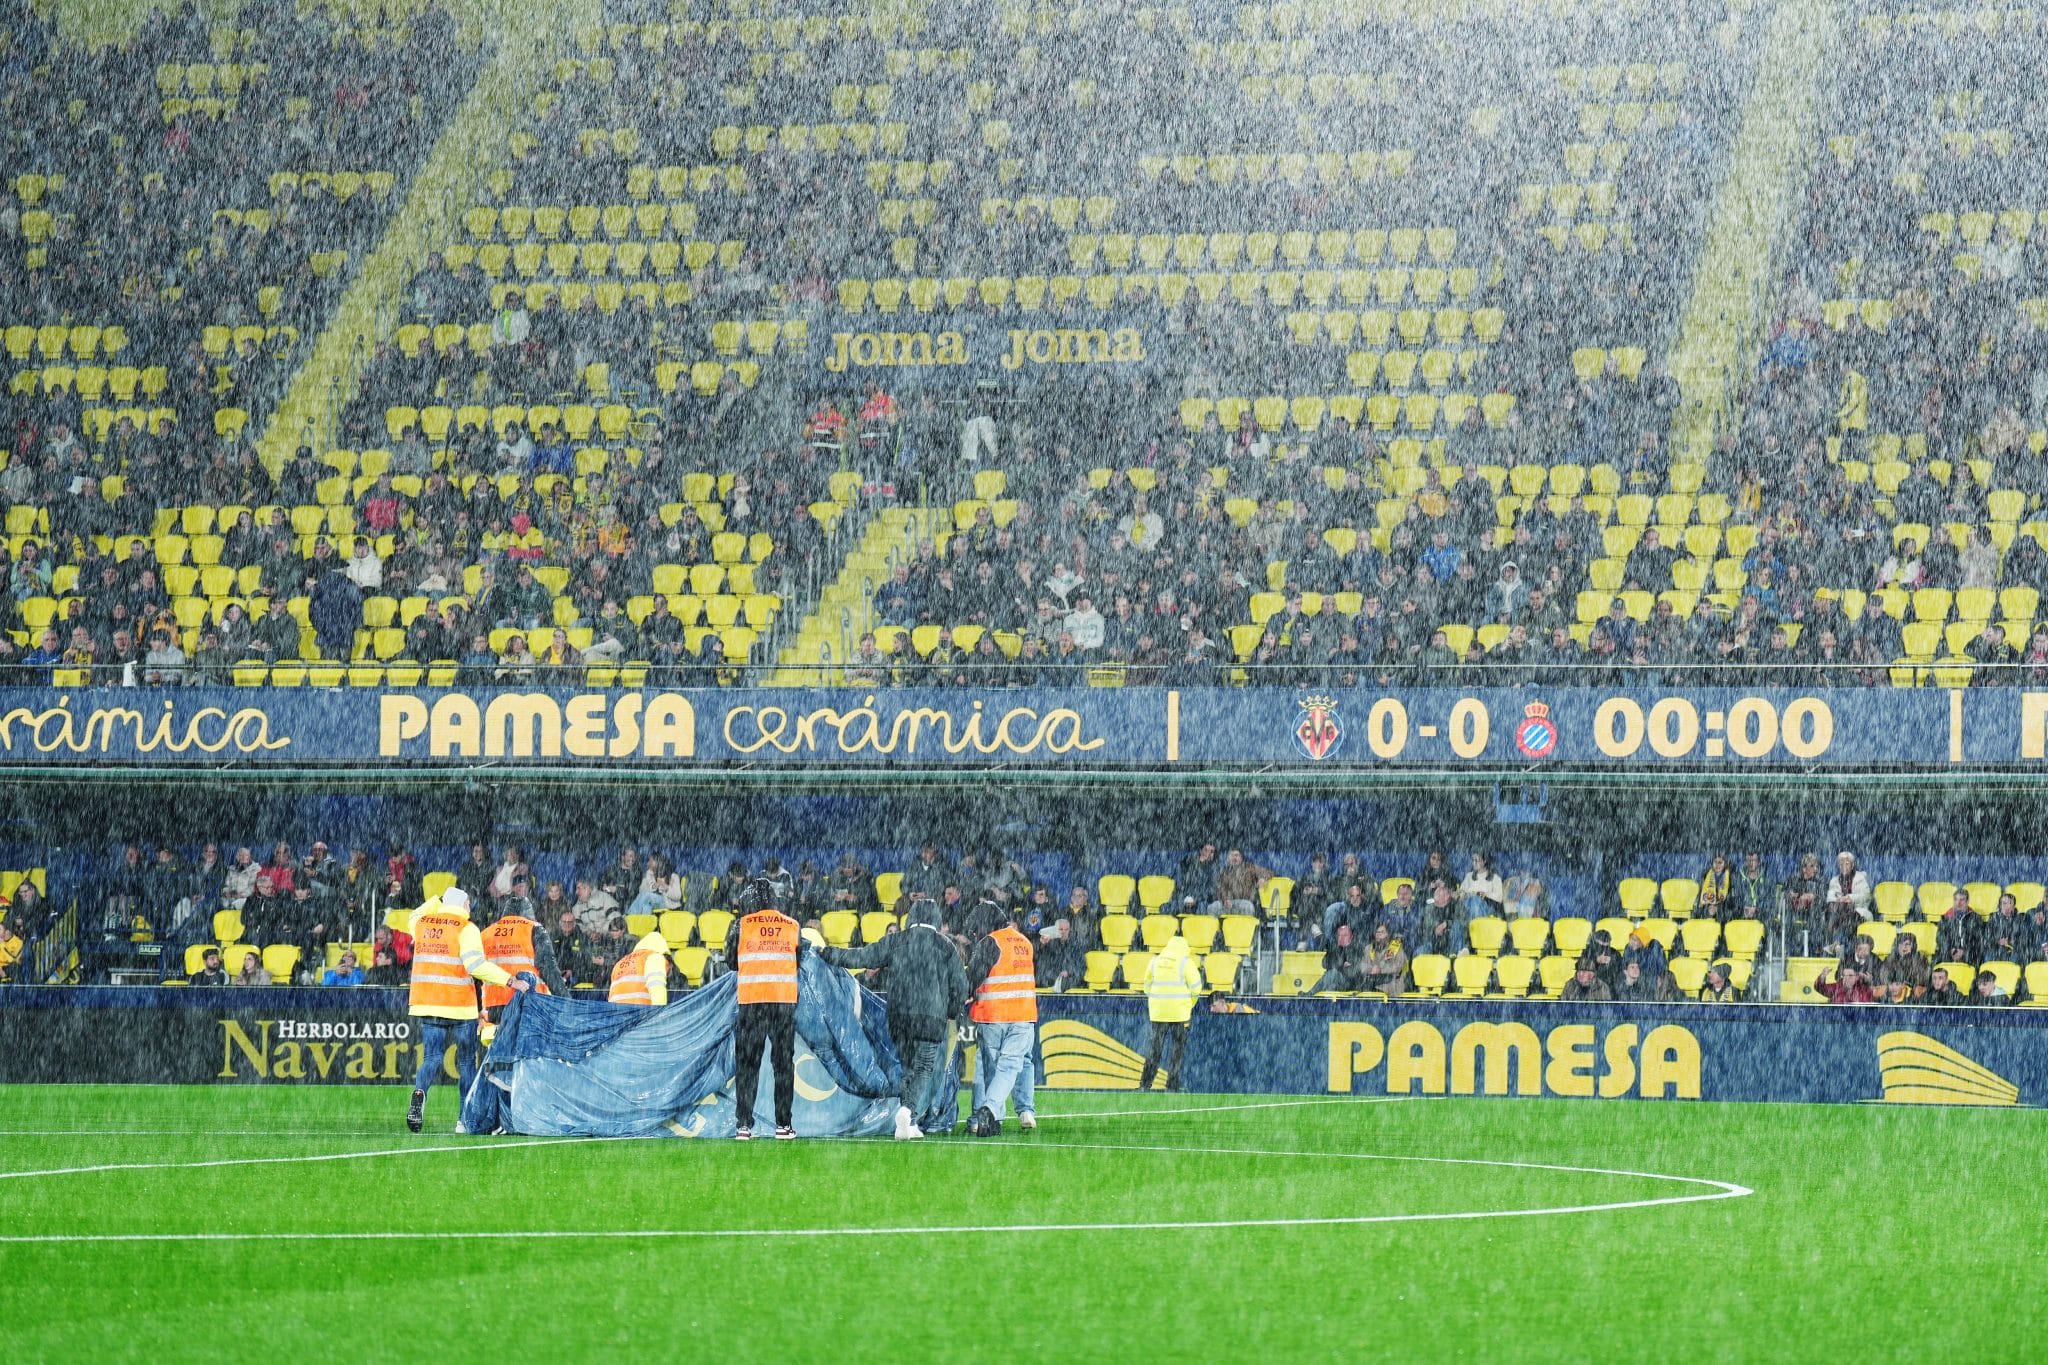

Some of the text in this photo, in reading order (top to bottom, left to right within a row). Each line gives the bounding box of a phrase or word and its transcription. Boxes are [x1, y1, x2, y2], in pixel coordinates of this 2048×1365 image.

[380, 692, 1105, 758] PAMESA cerámica
[1594, 697, 1834, 758] 00:00
[420, 915, 461, 927] STEWARD
[494, 927, 514, 937] 231
[760, 926, 782, 937] 097
[278, 1019, 410, 1039] HERBOLARIO
[1328, 1020, 1701, 1098] PAMESA
